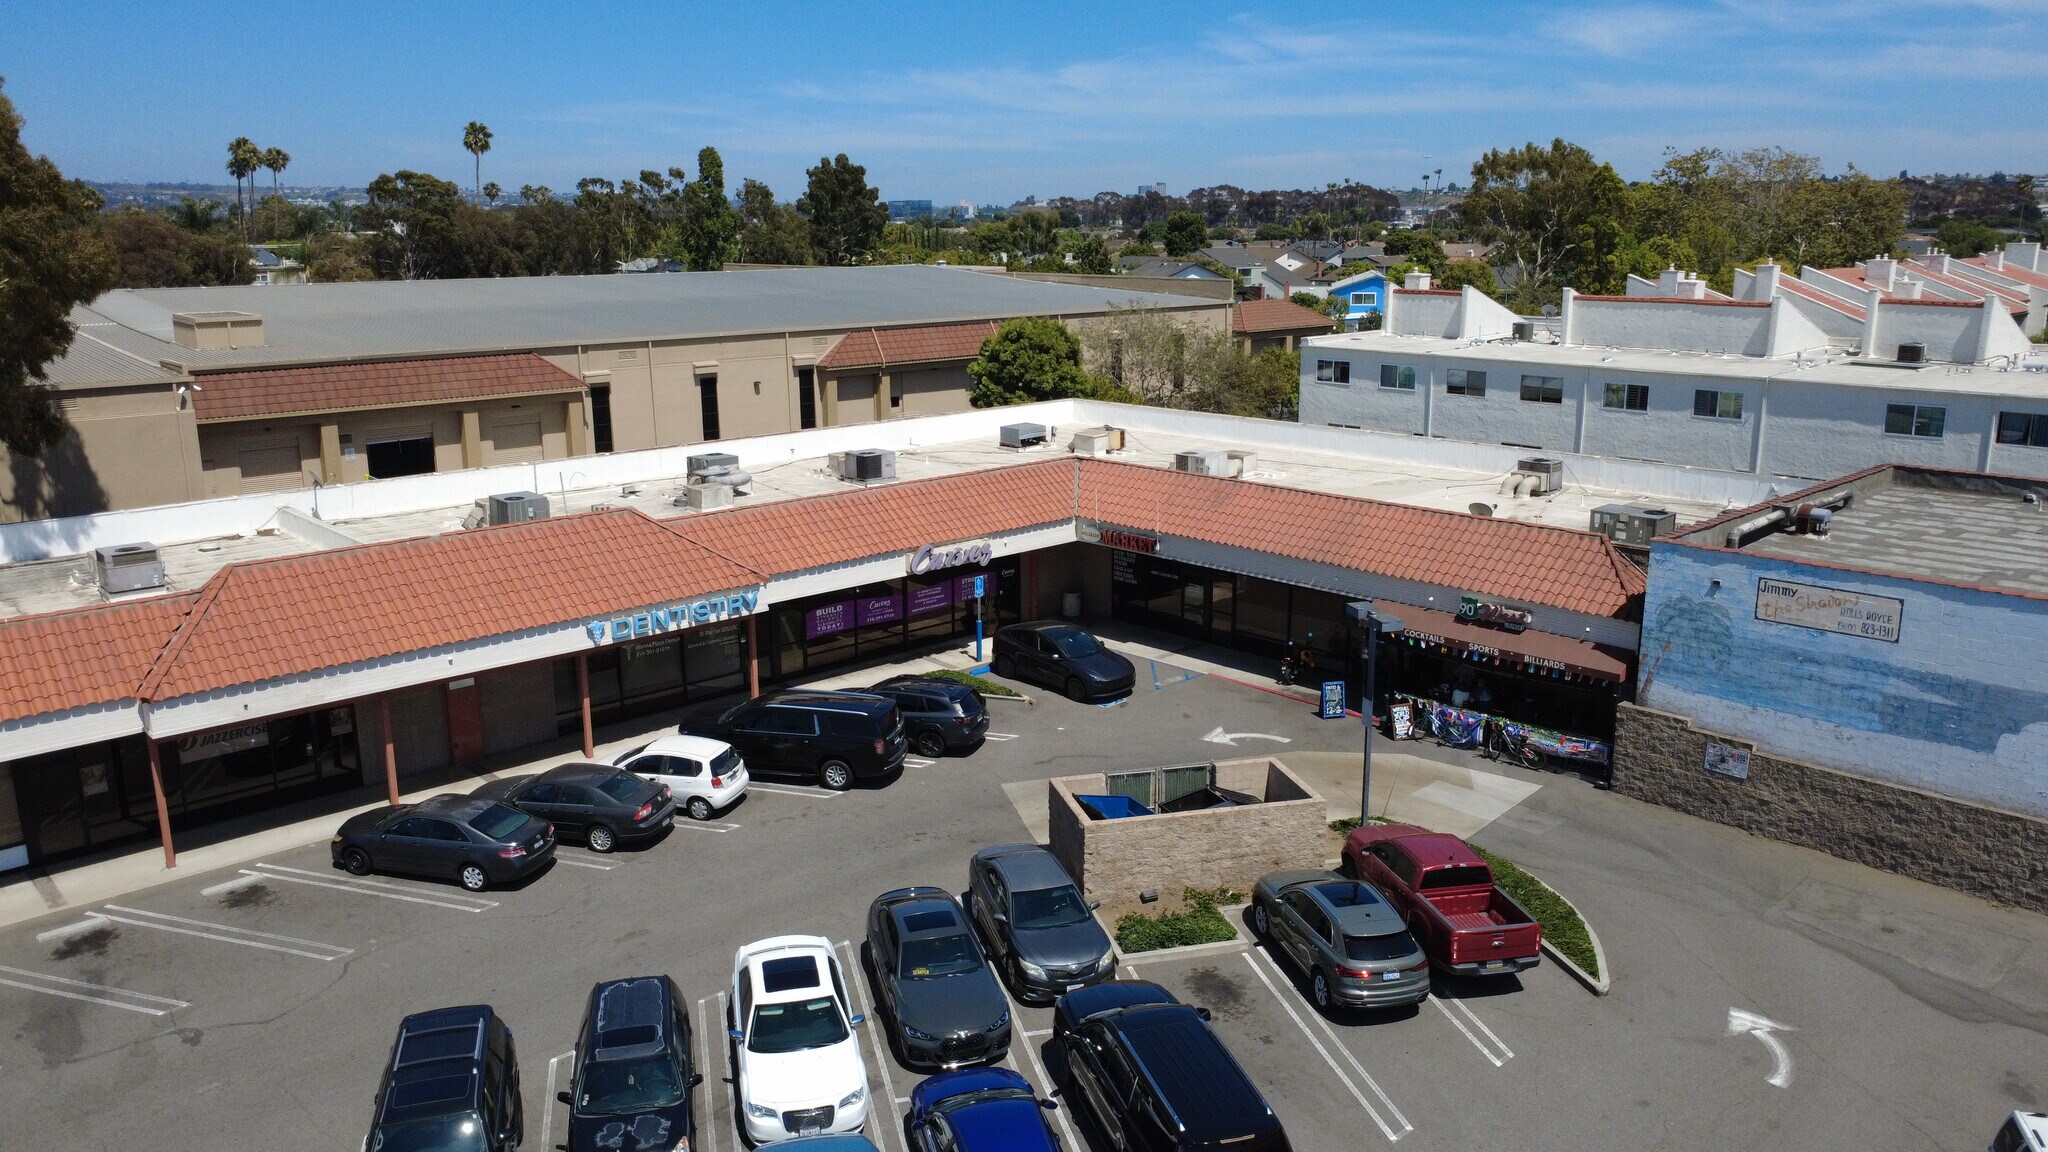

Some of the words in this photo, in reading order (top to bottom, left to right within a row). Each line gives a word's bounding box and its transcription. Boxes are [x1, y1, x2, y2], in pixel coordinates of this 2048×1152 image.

[1102, 529, 1156, 554] MARKET
[912, 544, 993, 576] Curves
[1760, 581, 1798, 598] Jimmy
[816, 604, 843, 616] BUILD
[869, 599, 891, 610] Curves
[1459, 603, 1475, 617] 90
[1762, 600, 1792, 620] the
[1796, 594, 1860, 612] Shadow
[612, 591, 758, 639] DENTISTRY
[1840, 608, 1863, 619] ROLLS
[1866, 612, 1893, 624] ROYCE
[817, 622, 844, 632] TODAY!
[1860, 622, 1894, 638] 823-1311
[1404, 629, 1445, 644] COCKTAILS
[1468, 643, 1500, 656] SPORTS
[1524, 654, 1566, 670] BILLIARDS
[200, 722, 269, 747] JAZZERCISE
